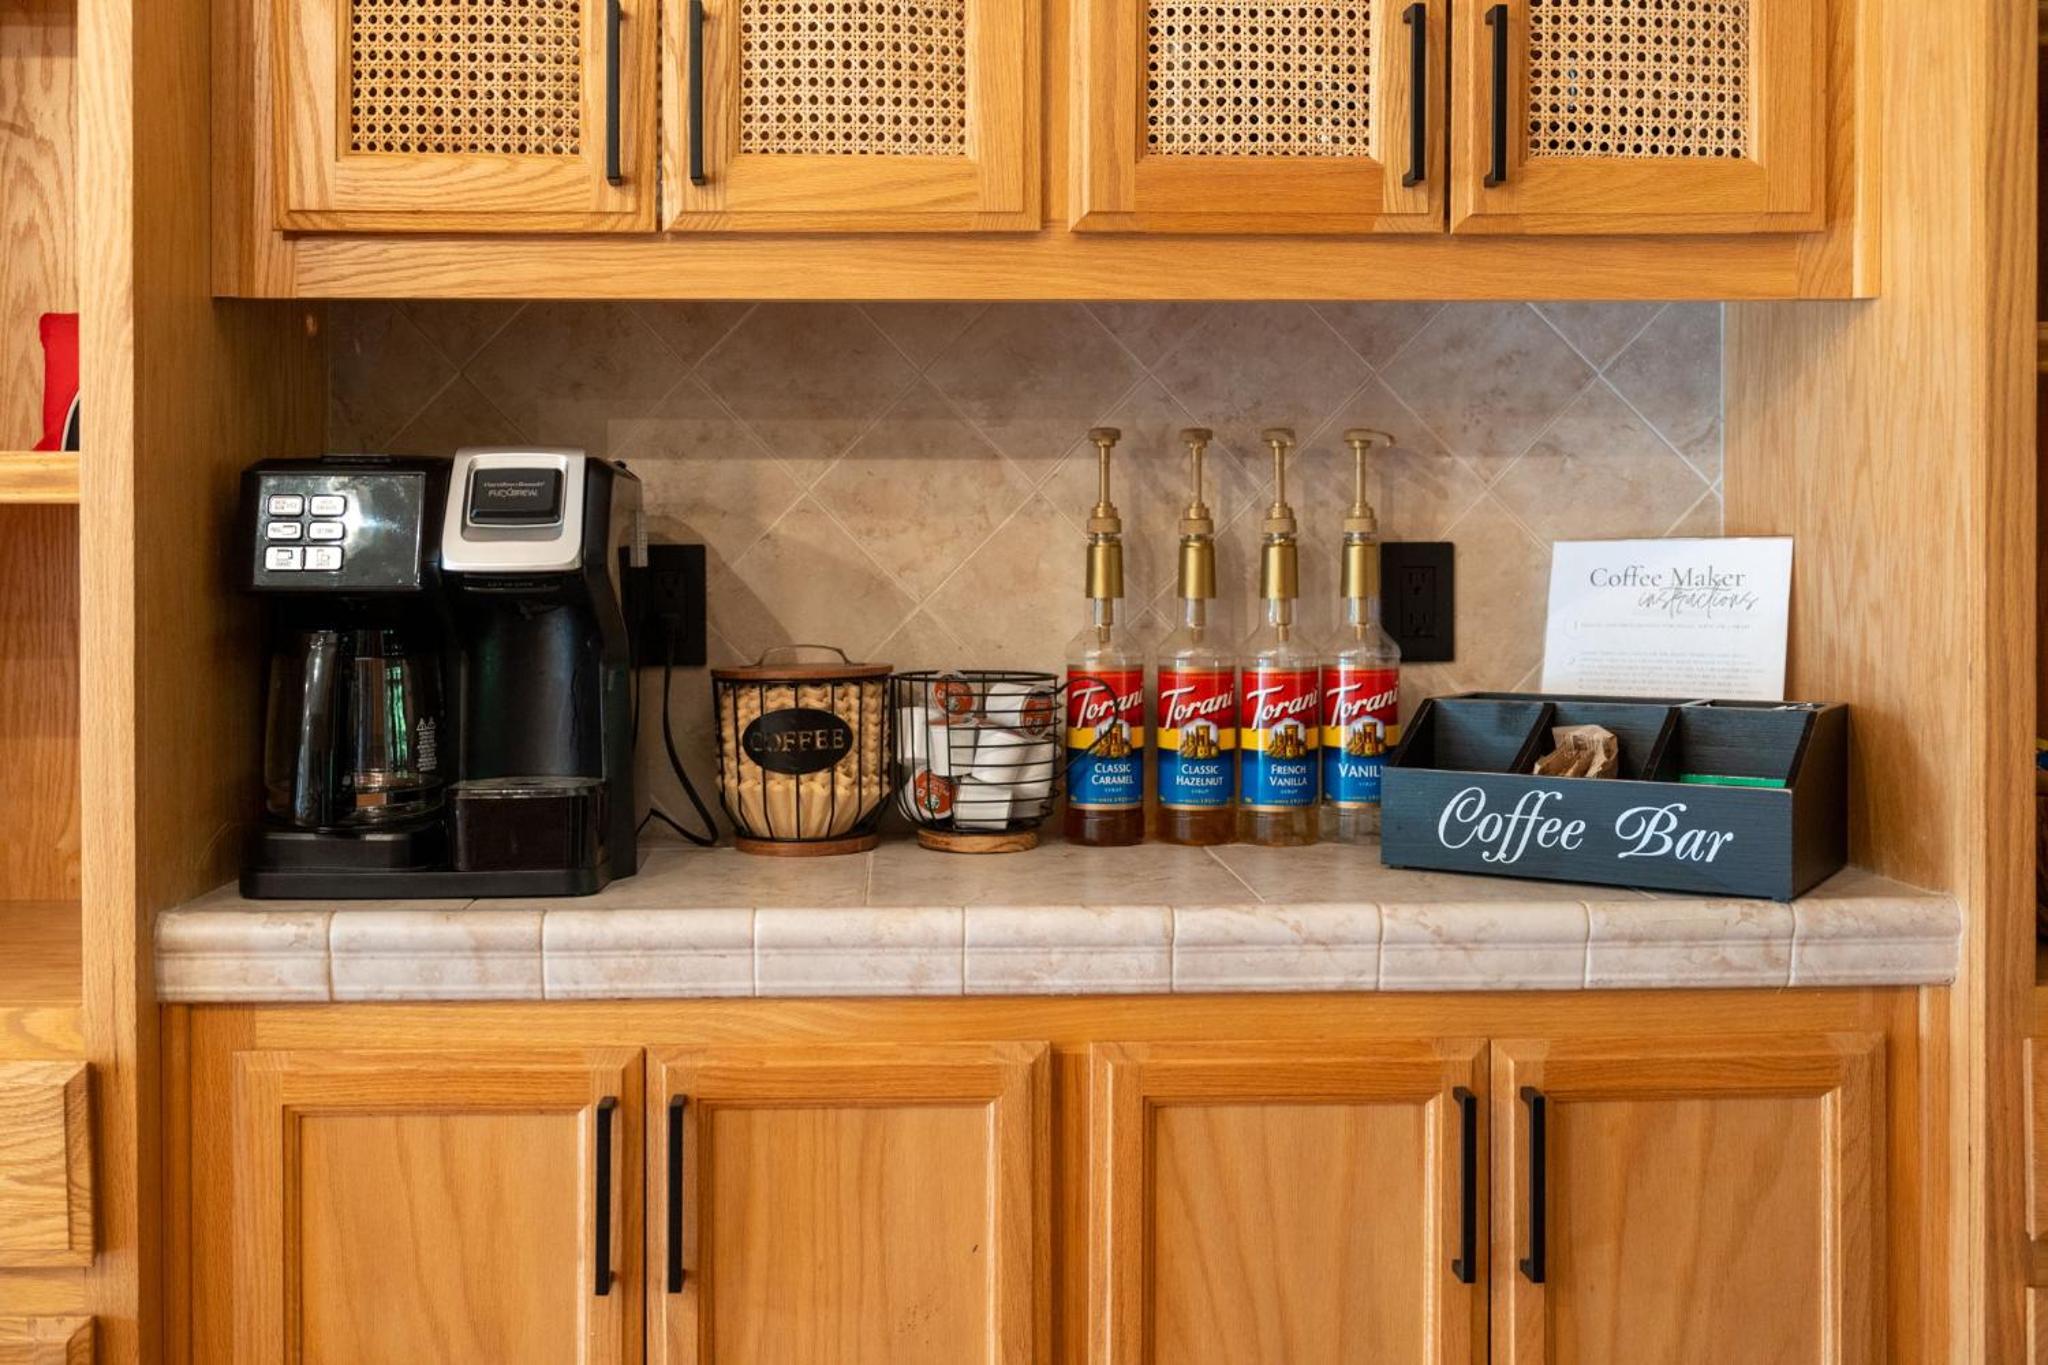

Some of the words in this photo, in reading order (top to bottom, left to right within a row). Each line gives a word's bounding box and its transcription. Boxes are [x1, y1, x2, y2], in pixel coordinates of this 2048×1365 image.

[1589, 565, 1662, 588] Coffee
[1671, 565, 1747, 588] Maker
[1072, 682, 1144, 729] Torani
[1161, 684, 1235, 730] Torani
[1247, 683, 1319, 731] Torani
[1326, 681, 1399, 728] Torani
[750, 728, 845, 753] COFFEE
[1094, 762, 1132, 774] CLASSIC
[1181, 763, 1219, 775] CLASSIC
[1270, 763, 1307, 775] FRENCH
[1338, 763, 1383, 778] VANIL
[1091, 774, 1135, 786] CARAMEL
[1175, 775, 1224, 787] HAZELNUT
[1269, 776, 1308, 787] VANILLA
[1437, 786, 1587, 864] Coffee
[1614, 802, 1734, 863] Bar
